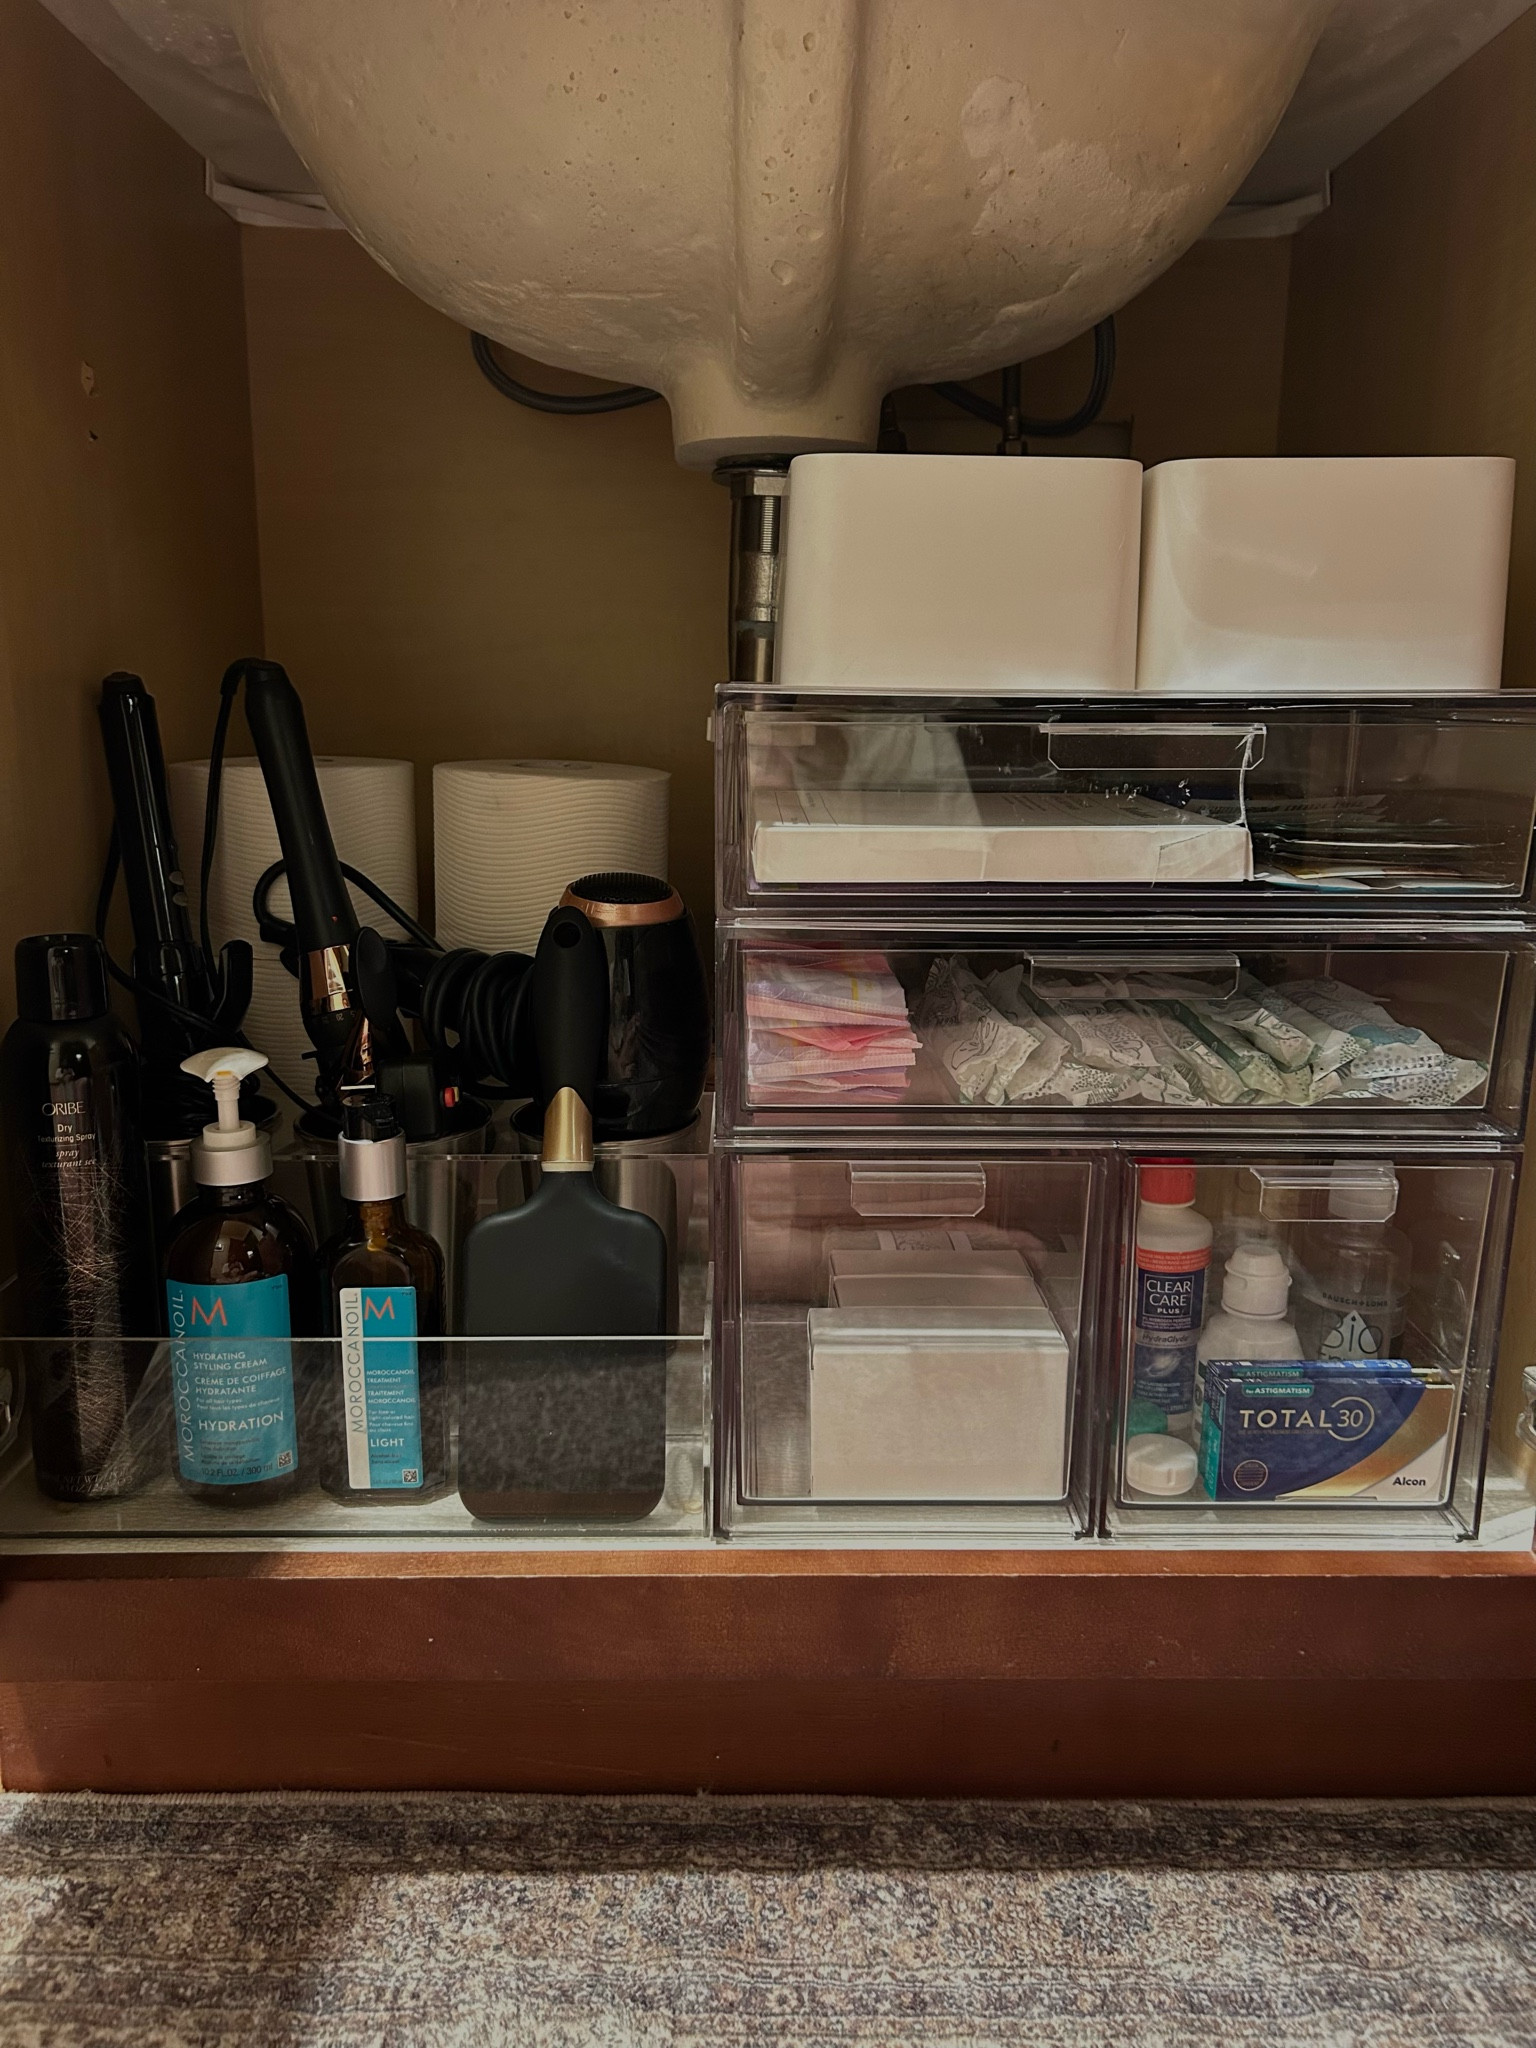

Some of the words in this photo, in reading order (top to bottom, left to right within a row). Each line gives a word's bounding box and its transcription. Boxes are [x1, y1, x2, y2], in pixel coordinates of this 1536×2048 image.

[42, 1101, 86, 1116] ORIBE
[57, 1124, 73, 1133] Dry
[38, 1135, 74, 1143] Texturizing
[76, 1133, 96, 1141] Spray
[56, 1150, 80, 1159] spray
[42, 1160, 82, 1168] texturant
[1146, 1280, 1191, 1293] CLEAR
[1150, 1294, 1187, 1306] CARE
[191, 1296, 228, 1326] M
[364, 1296, 395, 1320] M
[193, 1351, 246, 1360] HYDRATING
[193, 1362, 231, 1370] STYLING
[234, 1358, 268, 1369] CREAM
[345, 1296, 364, 1433] MOROCCANOIL
[171, 1293, 195, 1462] MOROCCANOIL
[227, 1376, 239, 1385] DE
[242, 1366, 287, 1383] COIFFAGE
[195, 1385, 257, 1395] HYDRATANTE
[1254, 1387, 1310, 1395] ASTIGMATISM
[199, 1411, 284, 1432] HYDRATION
[370, 1438, 405, 1447] LIGHT
[1393, 1476, 1426, 1486] Alcon
